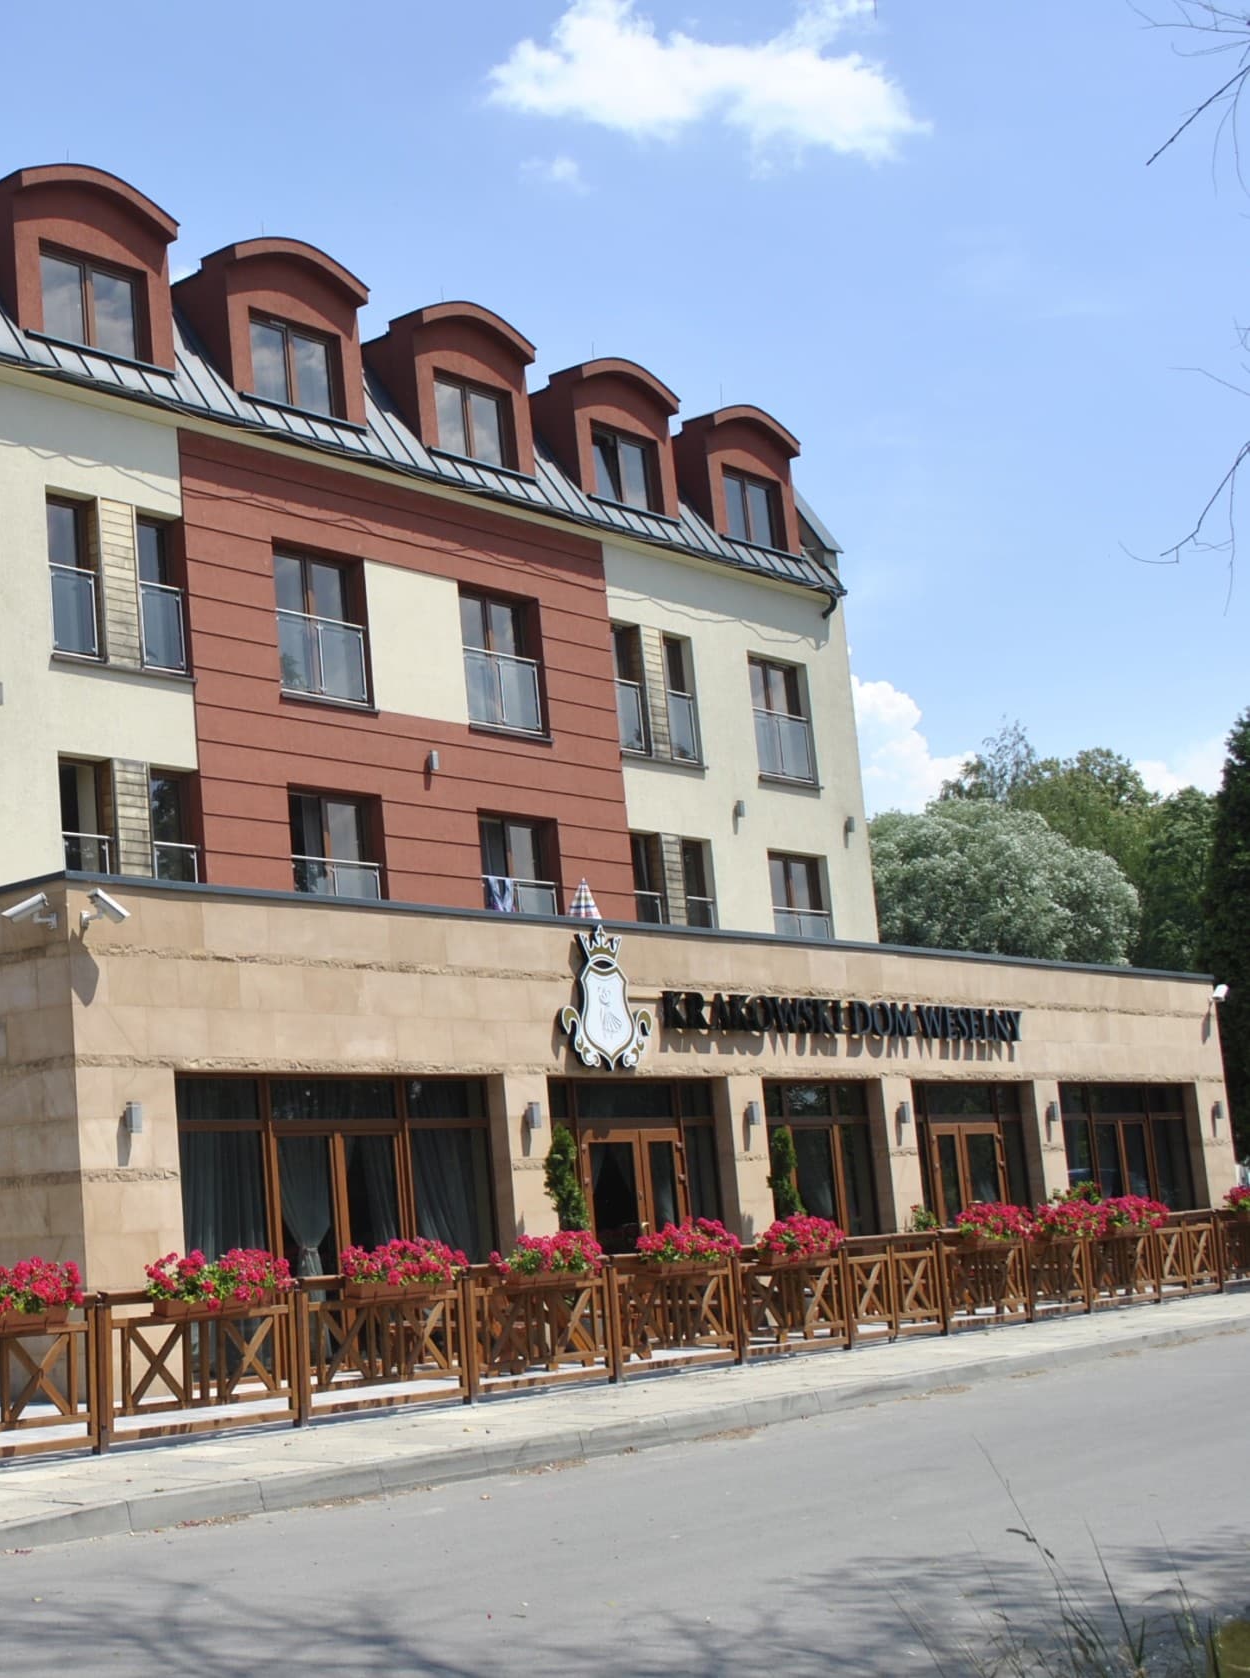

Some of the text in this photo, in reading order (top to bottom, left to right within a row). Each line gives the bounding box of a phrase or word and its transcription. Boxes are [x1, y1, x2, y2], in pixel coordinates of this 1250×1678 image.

[661, 991, 1022, 1042] KRAKOWSKI DOM WESELNY
